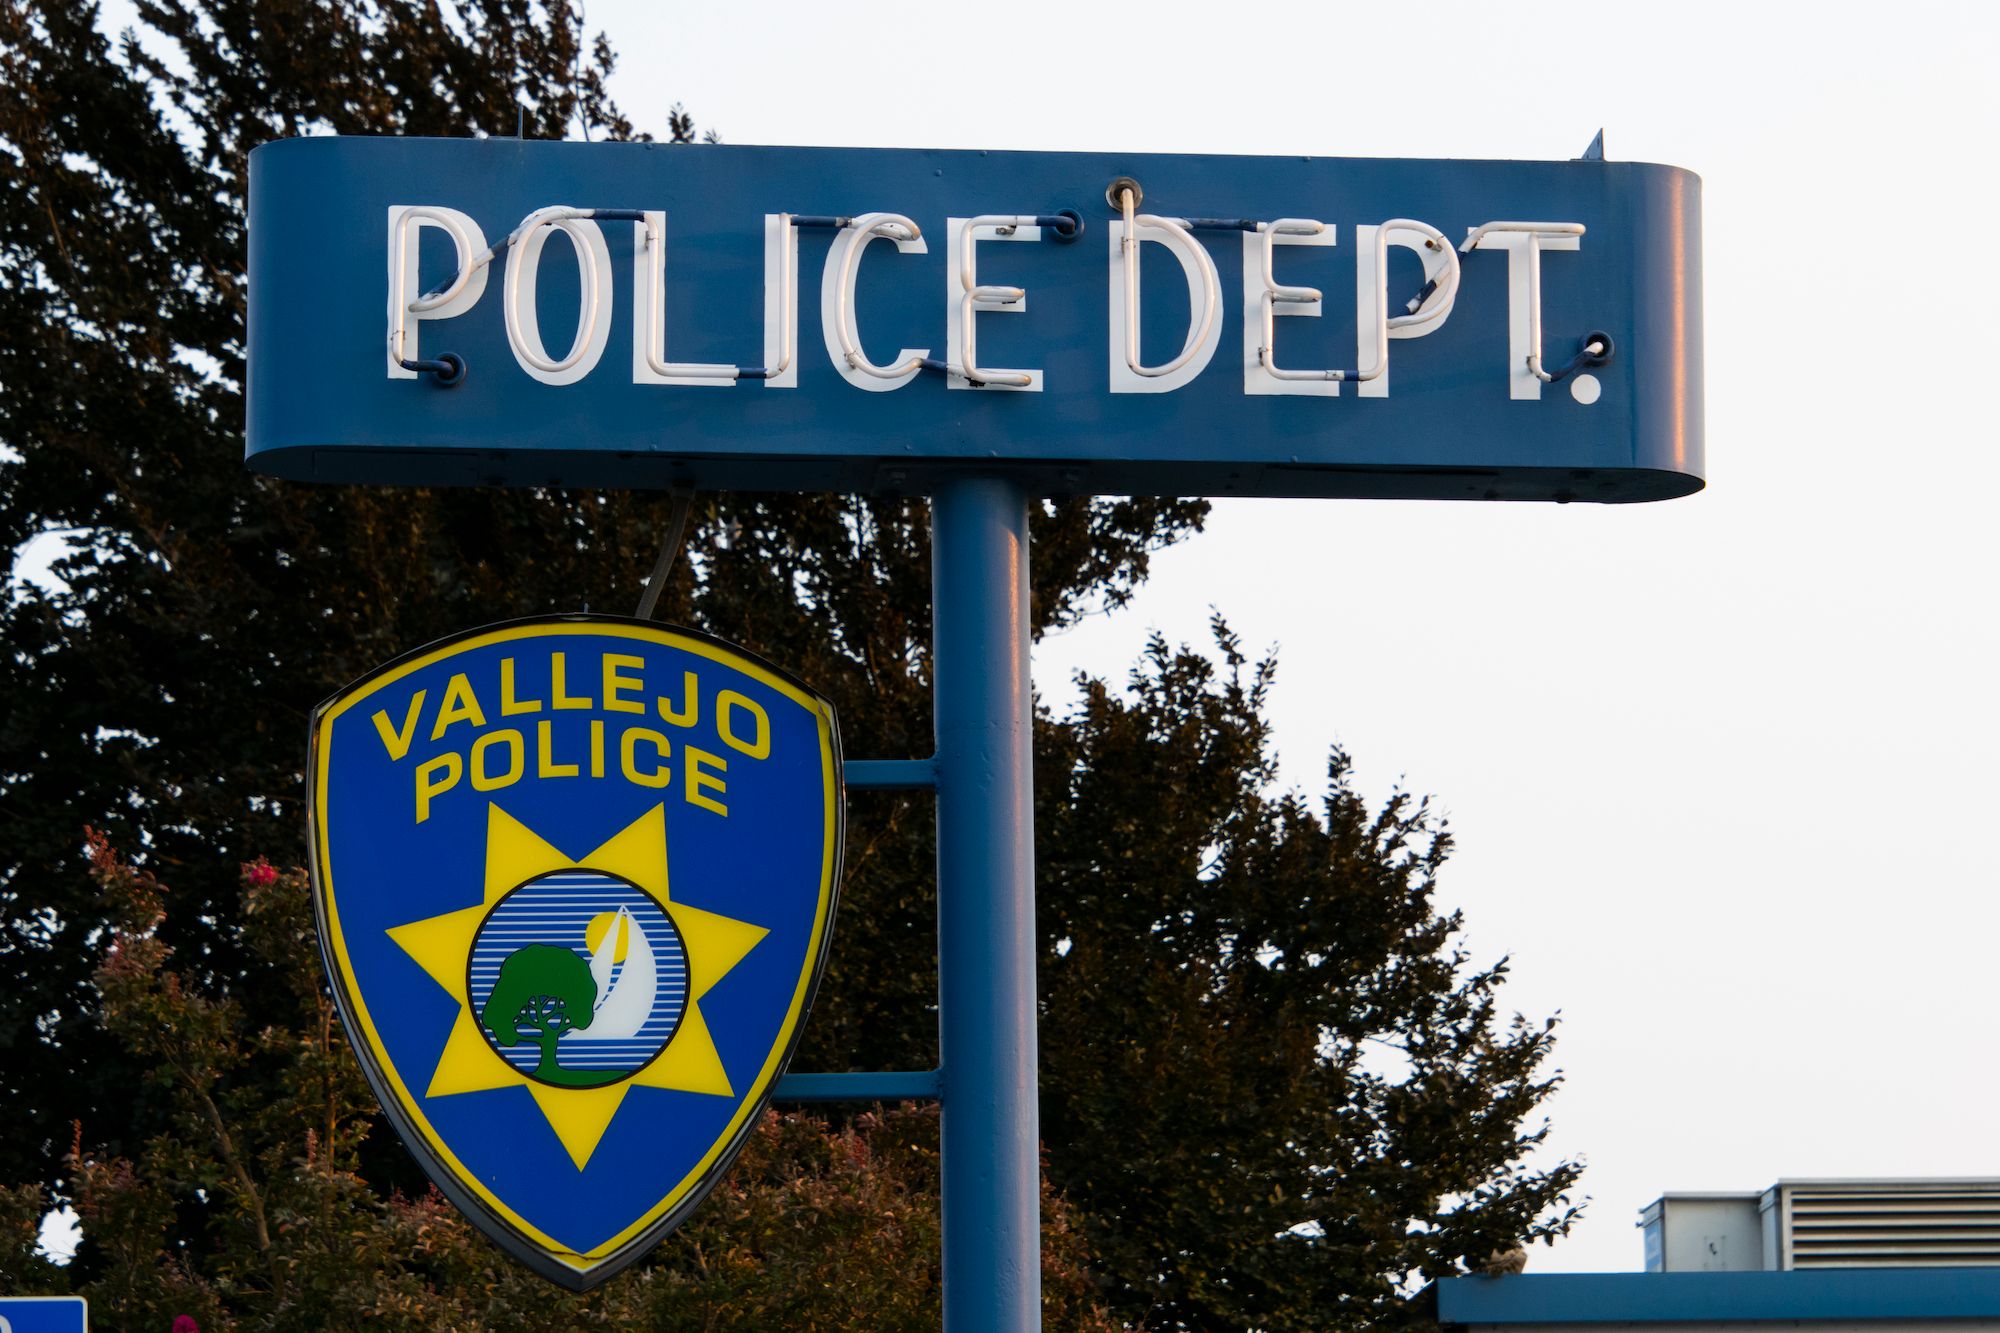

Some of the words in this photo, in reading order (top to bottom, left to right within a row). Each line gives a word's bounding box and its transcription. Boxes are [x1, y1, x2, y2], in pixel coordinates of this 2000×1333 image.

[386, 204, 1044, 393] POLICE
[1107, 214, 1603, 405] DEPT.
[371, 651, 771, 761] VALLEJO
[415, 719, 728, 823] POLICE
